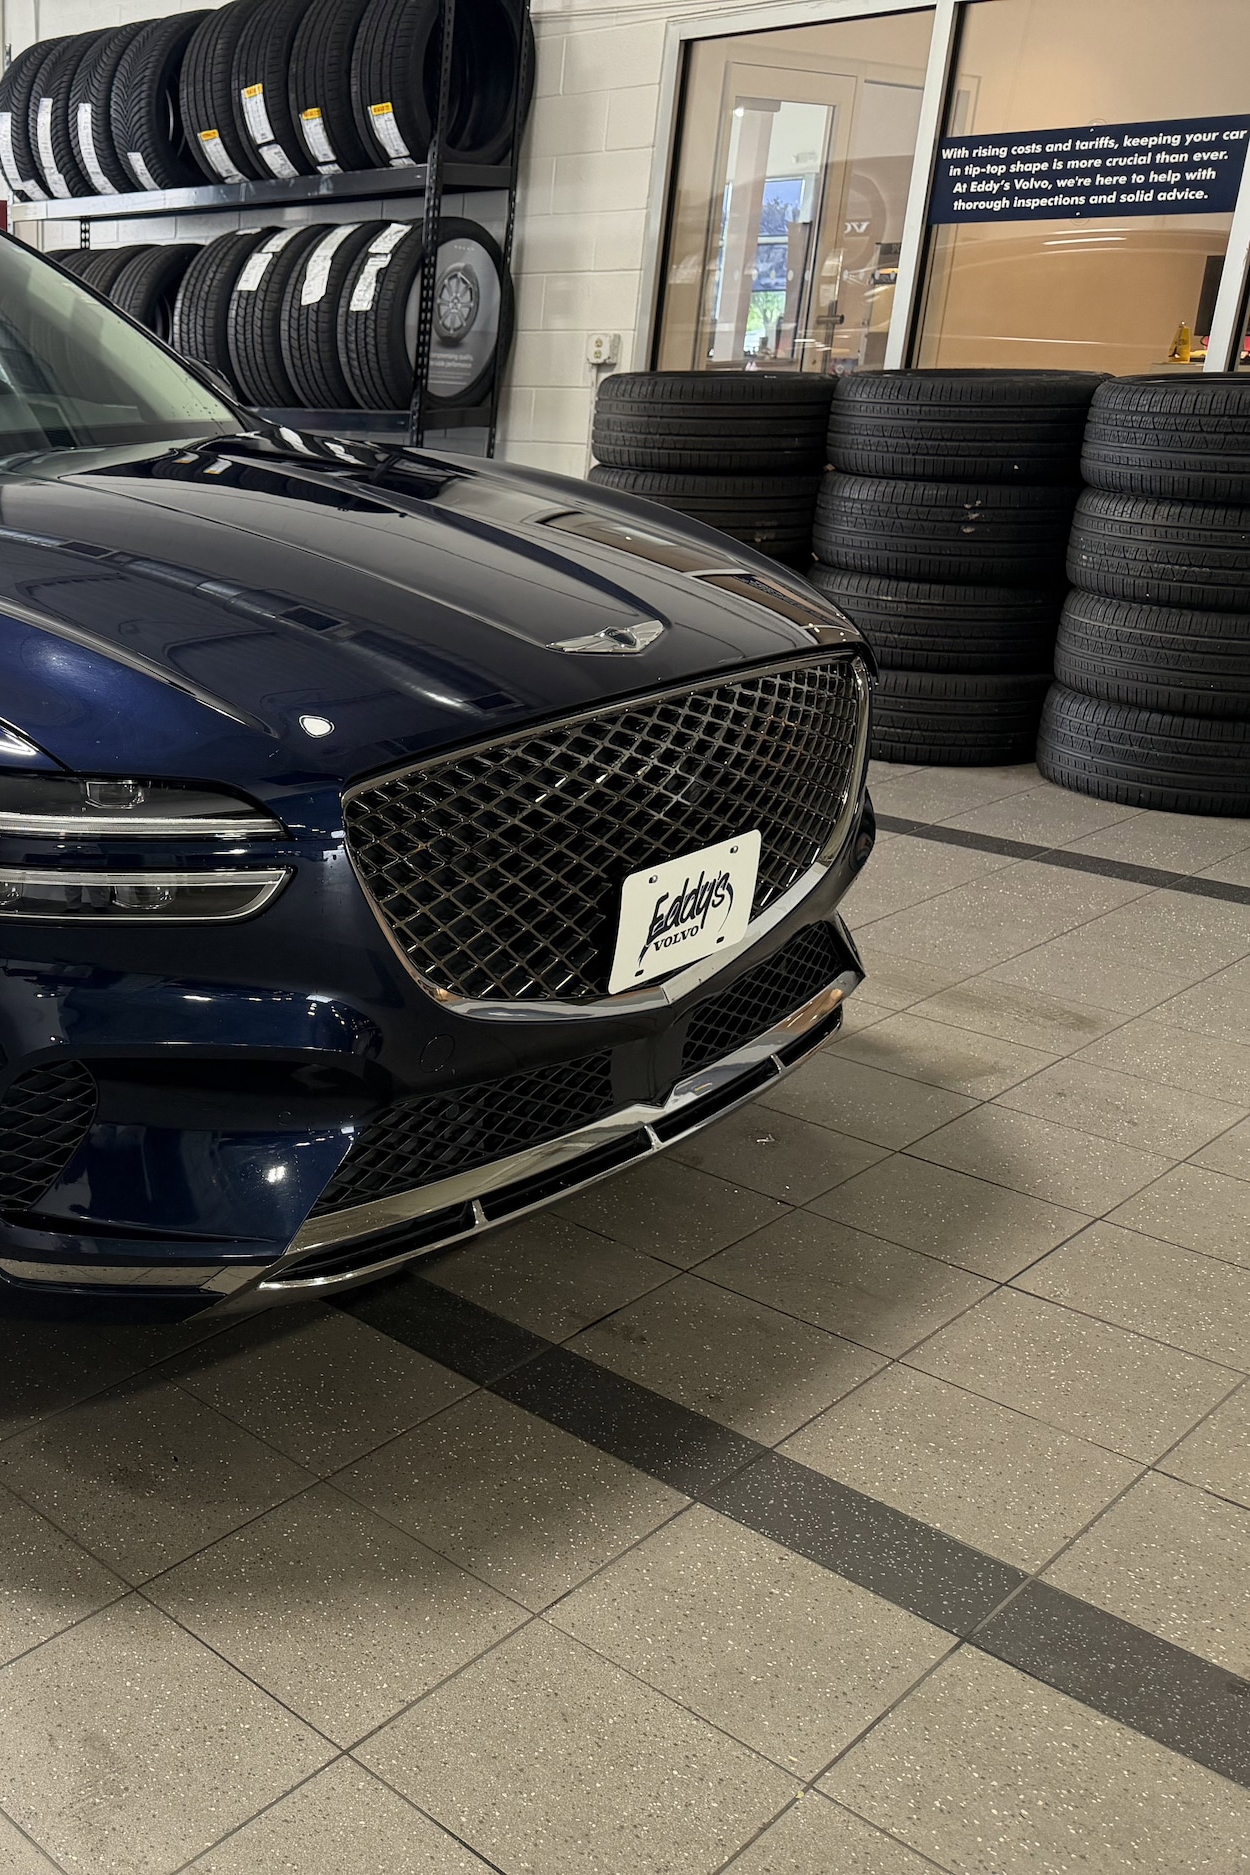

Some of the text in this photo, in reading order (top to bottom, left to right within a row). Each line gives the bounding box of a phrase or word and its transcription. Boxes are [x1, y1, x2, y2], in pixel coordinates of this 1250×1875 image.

[941, 129, 1248, 159] With rising costs and tariffs, keeping your car
[949, 150, 1228, 178] in tip-top shape is more crucial than ever.
[953, 167, 1216, 194] At Eddy's Volvo, we're here to help with
[953, 188, 1208, 211] thorough inspections and solid advice.
[646, 870, 730, 945] Eddy's
[653, 925, 699, 951] VOLVO
